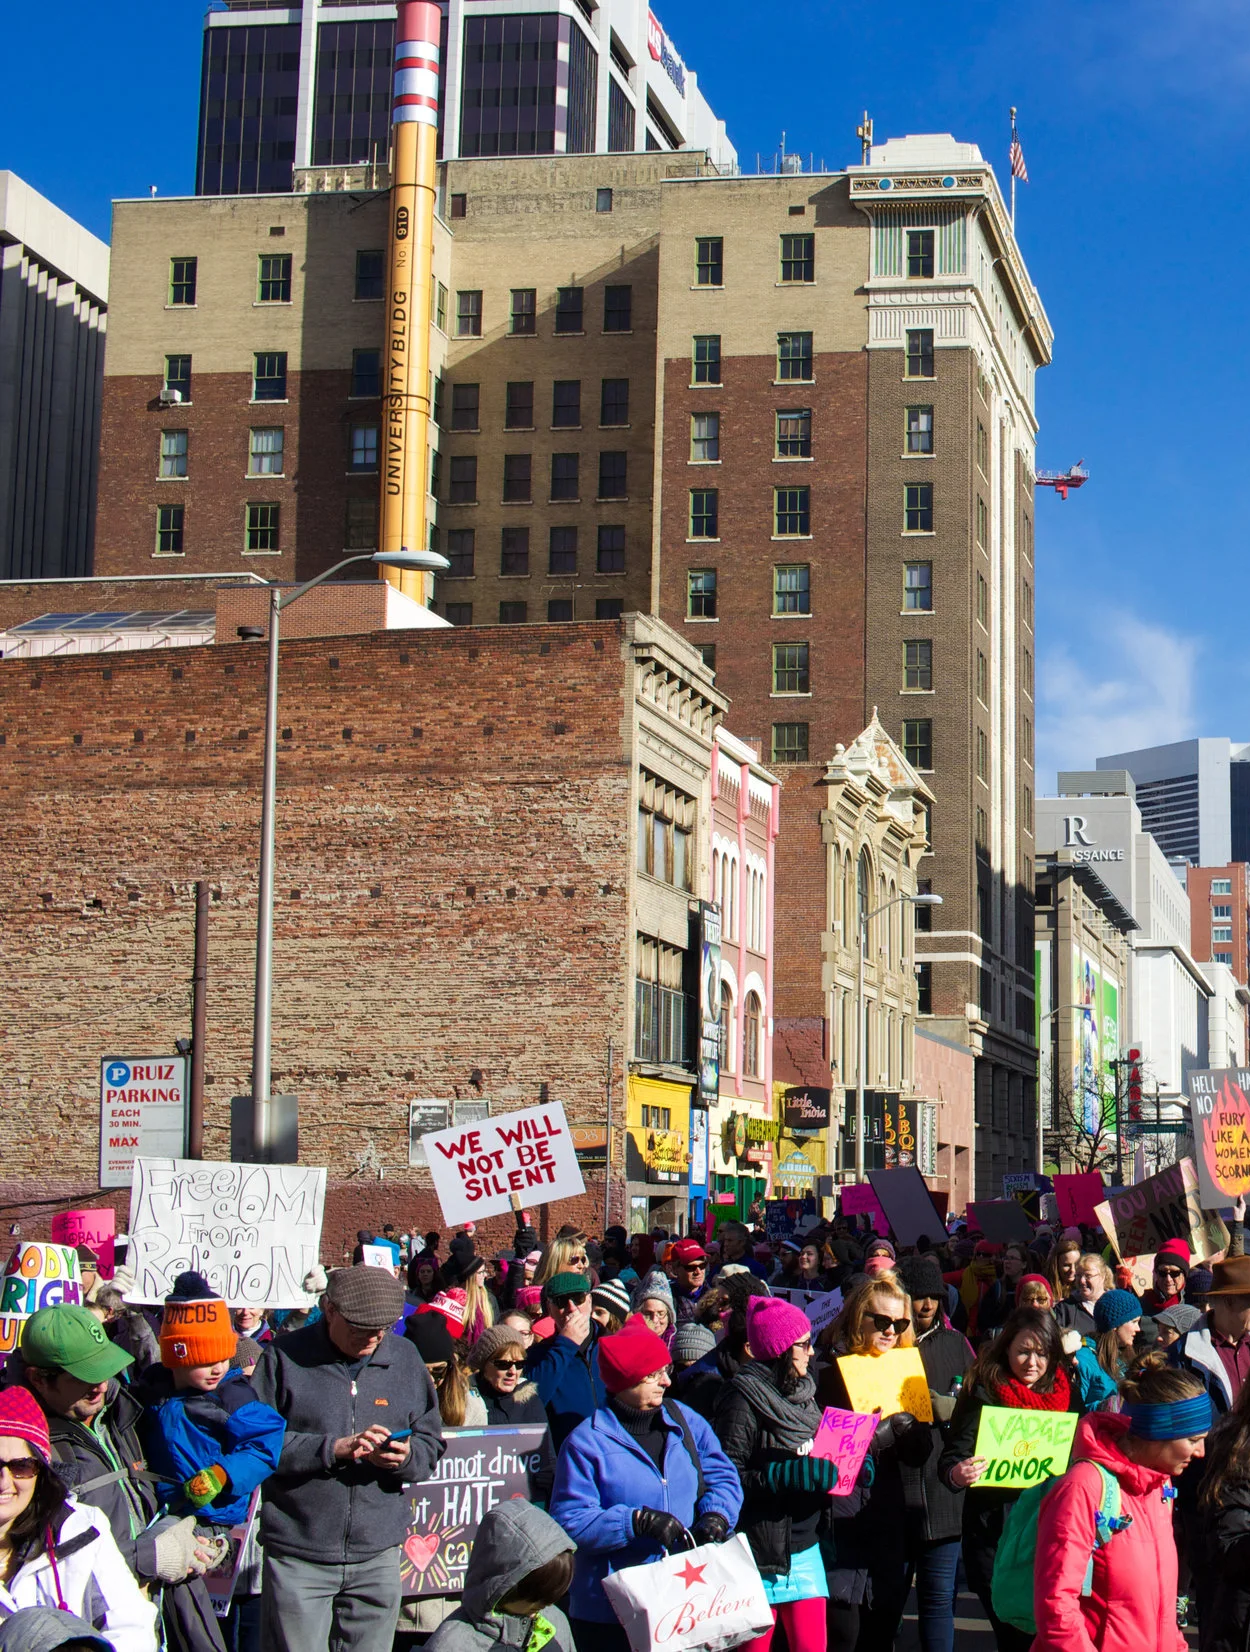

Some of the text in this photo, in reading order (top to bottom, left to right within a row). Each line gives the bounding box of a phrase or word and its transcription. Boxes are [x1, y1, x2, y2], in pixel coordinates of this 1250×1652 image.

[397, 210, 408, 236] 910
[387, 291, 407, 495] UNIVERSITY BLDG
[1063, 815, 1098, 847] R
[1073, 849, 1125, 861] SSANCE
[111, 1065, 176, 1081] P RUIZ
[1192, 1075, 1218, 1094] HELL
[106, 1088, 181, 1103] PARKING
[786, 1093, 813, 1109] Little
[1196, 1095, 1213, 1115] NO
[111, 1109, 141, 1117] EACH
[800, 1103, 827, 1119] India
[1219, 1112, 1245, 1126] FURY
[122, 1120, 142, 1128] MIN.
[898, 1104, 915, 1151] BBQ
[109, 1136, 139, 1147] MAX
[434, 1130, 483, 1160] WE
[496, 1115, 562, 1147] WILL
[1211, 1130, 1250, 1143] LIKE A
[457, 1139, 553, 1180] NOT BE
[465, 1161, 556, 1202] SILENT
[63, 1231, 108, 1245] LOBAL
[178, 1213, 259, 1248] From
[4, 1243, 78, 1279] BODY
[0, 1278, 84, 1314] RIGH
[165, 1303, 217, 1325] ONCOS
[810, 1305, 841, 1326] VOLUTION
[821, 1410, 868, 1435] KEEP
[1013, 1440, 1040, 1457] OF
[429, 1446, 541, 1480] annot drive
[445, 1541, 475, 1565] ca
[654, 1584, 756, 1643] Believe
